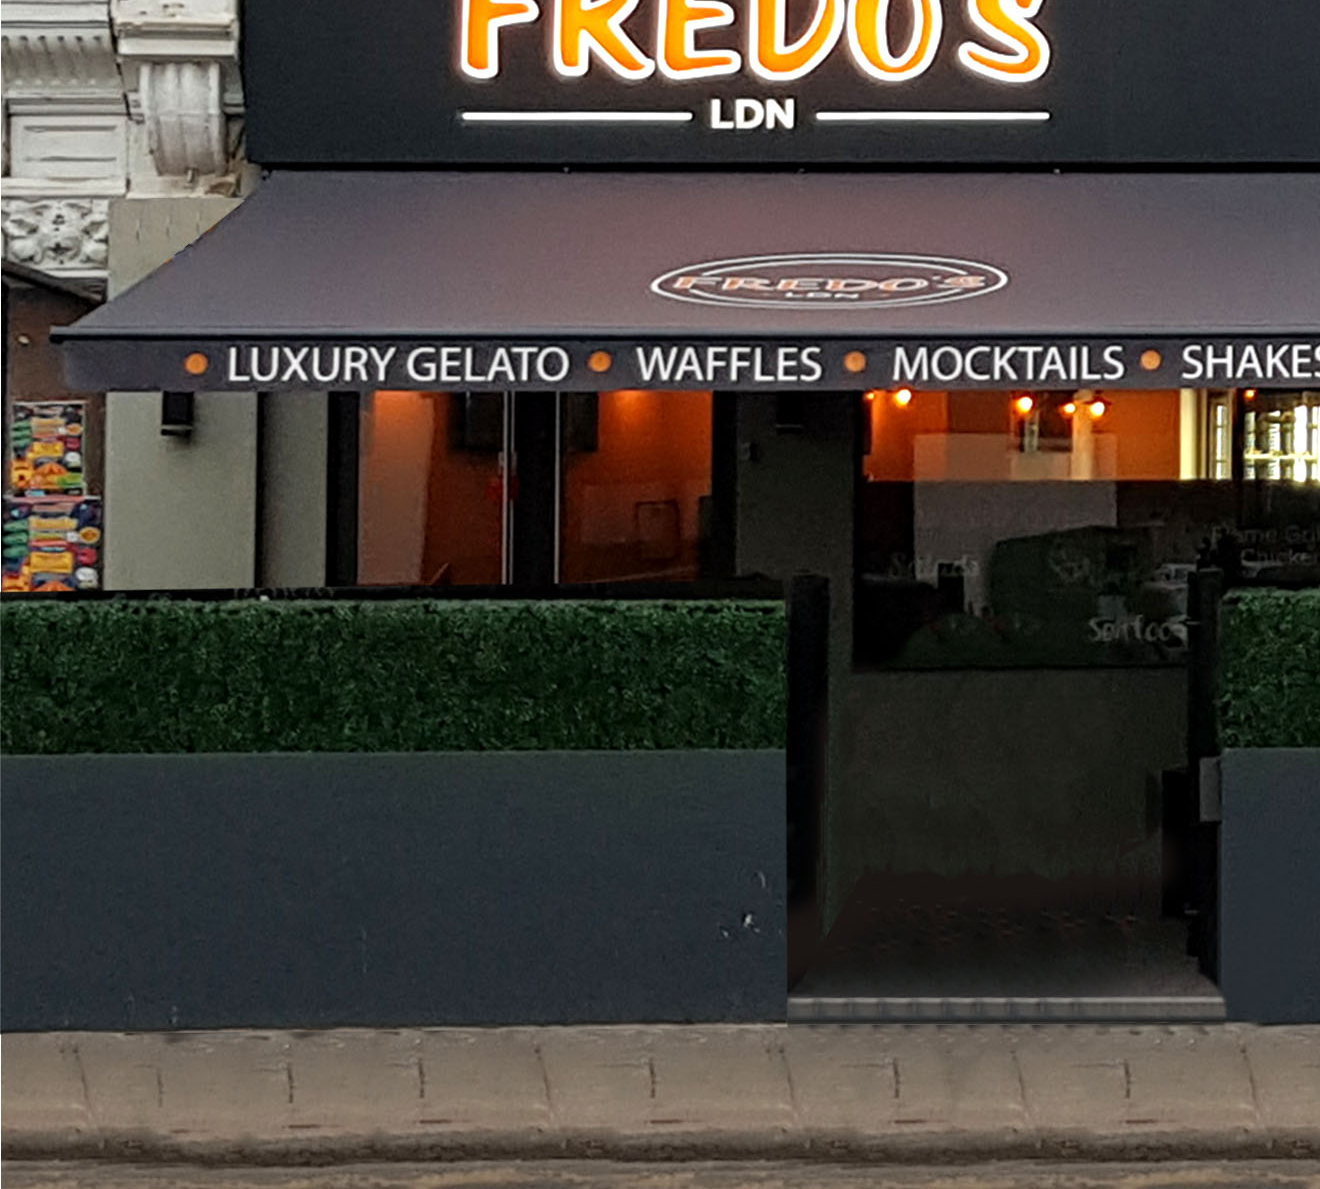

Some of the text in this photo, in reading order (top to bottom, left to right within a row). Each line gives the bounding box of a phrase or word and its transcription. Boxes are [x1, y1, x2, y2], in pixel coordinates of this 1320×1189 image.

[711, 98, 795, 130] LDN
[672, 274, 987, 291] FREDO'S
[785, 291, 859, 299] LDN
[228, 347, 395, 381] LUXURY
[407, 347, 569, 381] GELATO
[637, 347, 822, 381] WAFFLES
[892, 346, 1125, 381] MOCKTAILS
